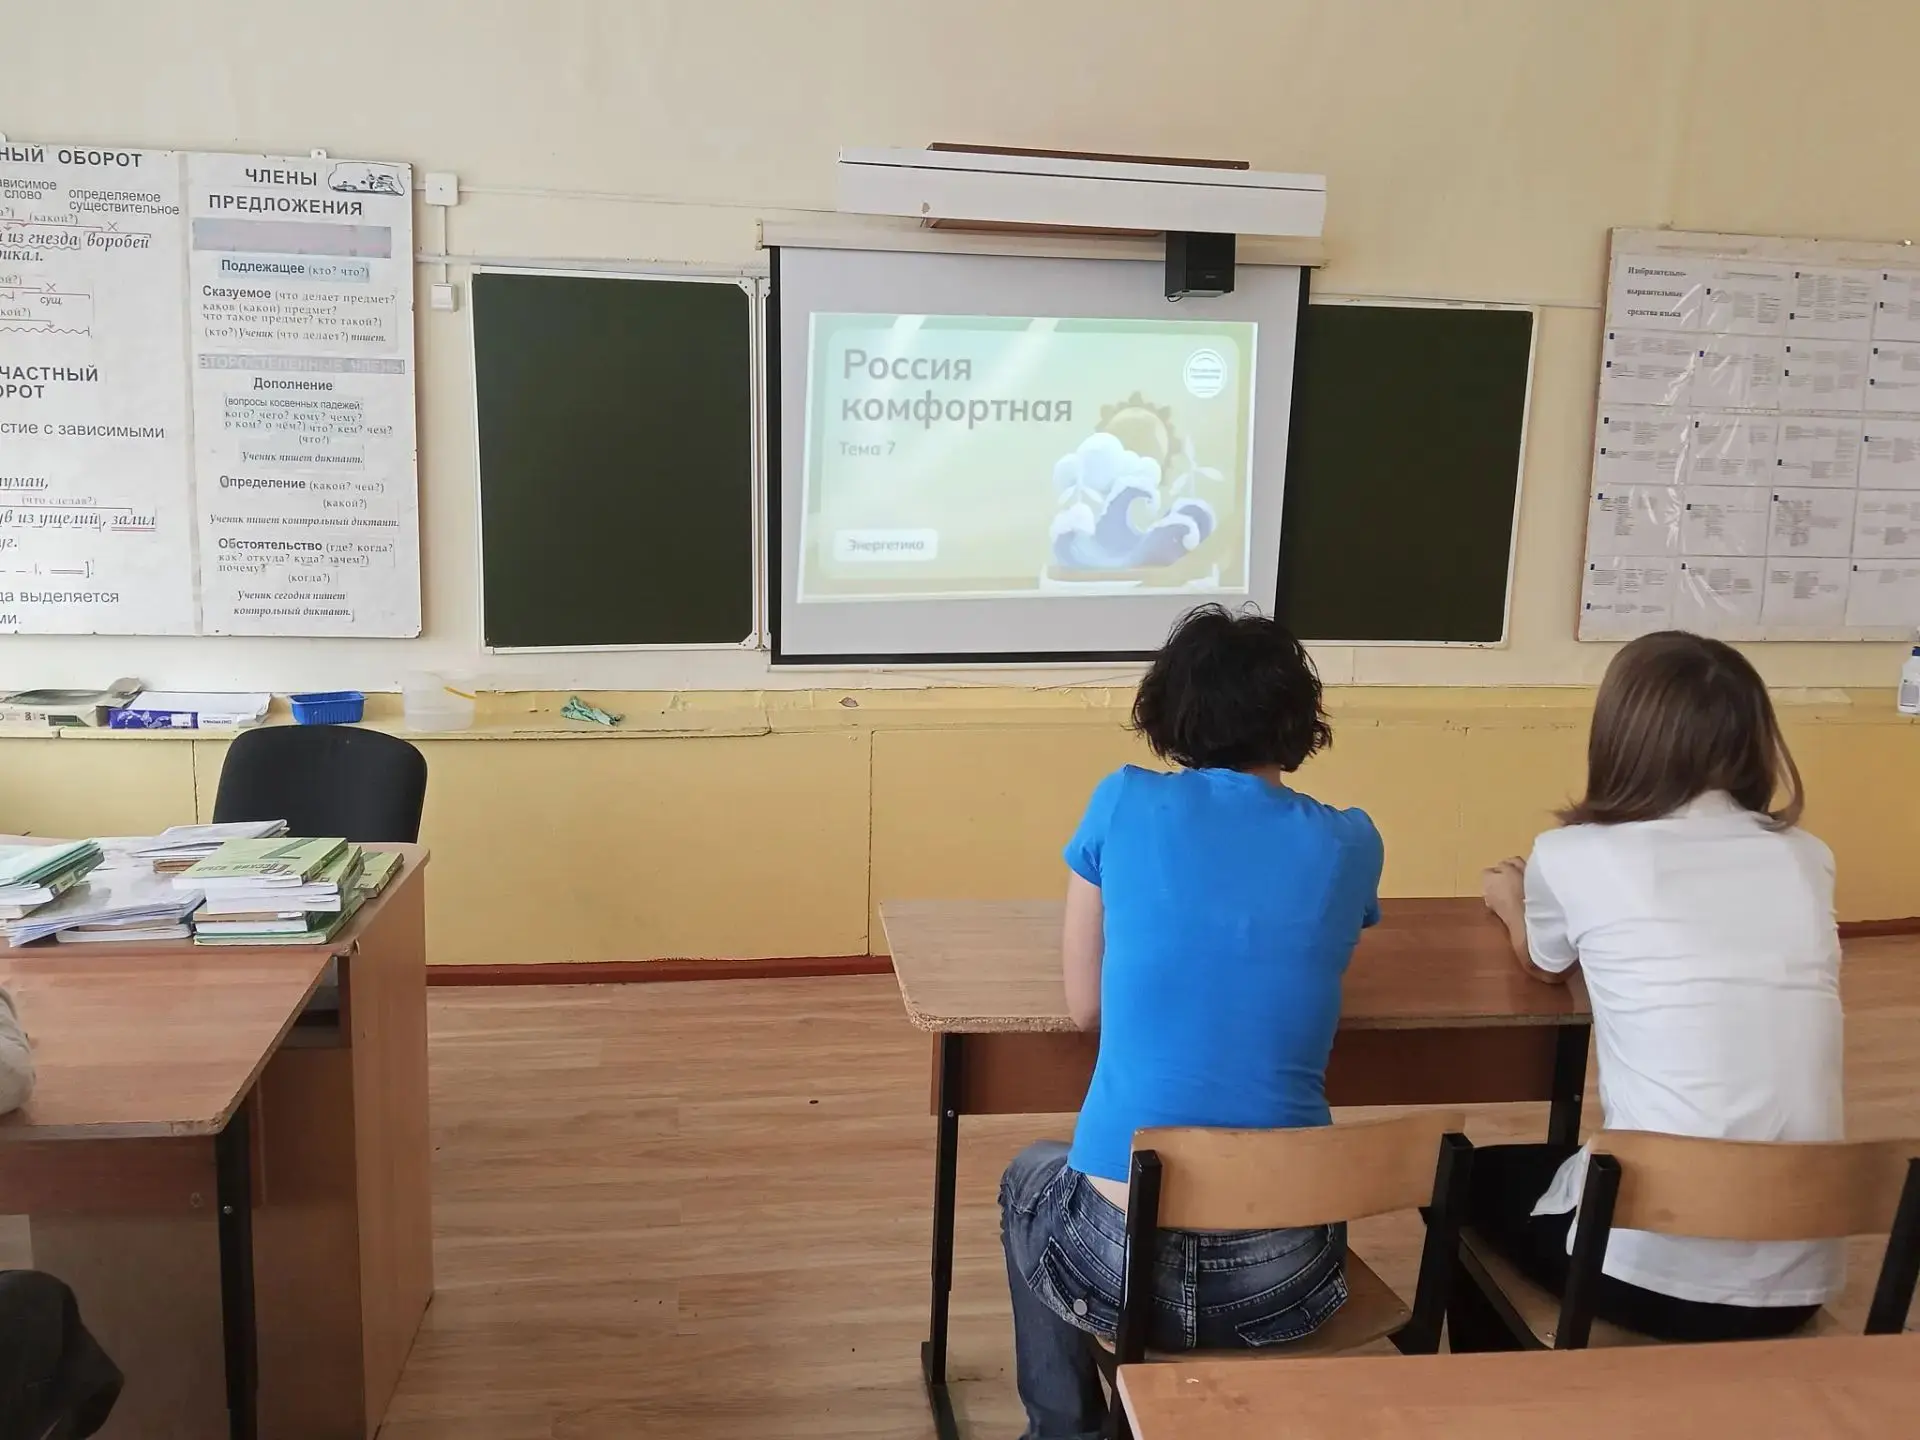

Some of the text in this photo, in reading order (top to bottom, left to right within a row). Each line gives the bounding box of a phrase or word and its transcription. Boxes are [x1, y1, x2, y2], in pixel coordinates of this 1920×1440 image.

[57, 150, 142, 168] ОБОРОТ
[245, 168, 317, 186] ЧЛЕНЫ
[4, 190, 42, 200] слово
[69, 189, 161, 203] определяемое
[69, 201, 180, 215] существительное
[208, 194, 363, 217] ПРЕДЛОЖЕНИЯ
[8, 232, 24, 243] из
[28, 231, 78, 245] гнезда
[87, 233, 150, 252] воробей
[221, 259, 370, 278] Подлежащее (кто? что?)
[202, 285, 396, 306] Сказуемое (что делает предмет?
[238, 326, 274, 340] Ученик
[843, 348, 972, 381] Россия
[0, 364, 98, 382] ЧАСТНЫЙ
[253, 377, 333, 391] Дополнение
[225, 396, 267, 408] (вопросы
[269, 399, 318, 410] косвенных
[841, 390, 1072, 430] комфортная
[0, 423, 165, 438] стие с зависимыми
[840, 440, 897, 456] Тема 7
[242, 451, 363, 464] Ученик пишет диктант.
[0, 477, 48, 489] уман,
[220, 475, 306, 489] Определение
[19, 513, 34, 523] из
[111, 517, 155, 526] залил
[210, 513, 244, 525] Ученик
[246, 515, 279, 525] пишет
[282, 516, 349, 528] контрольный
[218, 538, 322, 551] Обстоятельство
[846, 537, 925, 553] Энергетика
[20, 591, 119, 604] выделяется
[238, 590, 346, 601] Ученик сегодня пишет
[233, 606, 301, 618] контрольный
